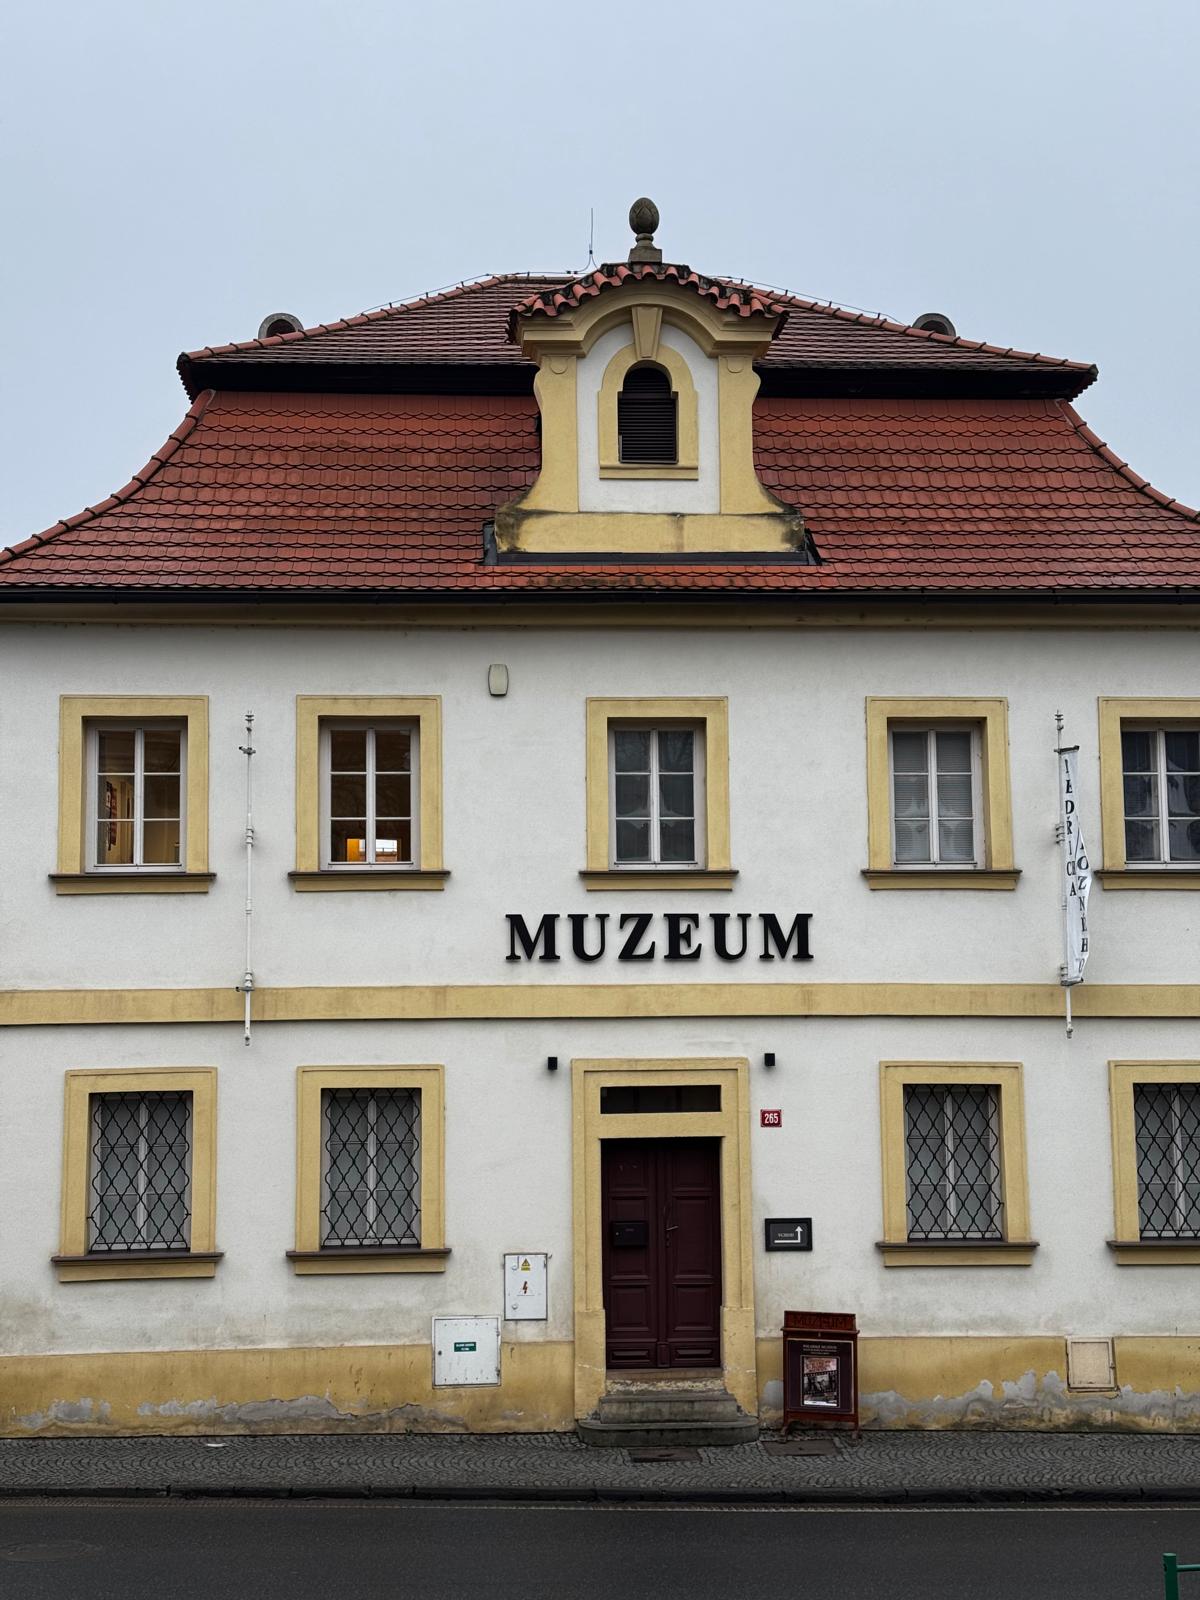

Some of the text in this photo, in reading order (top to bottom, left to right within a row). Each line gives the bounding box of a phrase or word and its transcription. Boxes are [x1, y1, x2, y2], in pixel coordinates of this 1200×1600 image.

[1064, 758, 1077, 896] EDŘICHA
[505, 913, 814, 961] MUZEUM
[764, 1113, 779, 1124] 265
